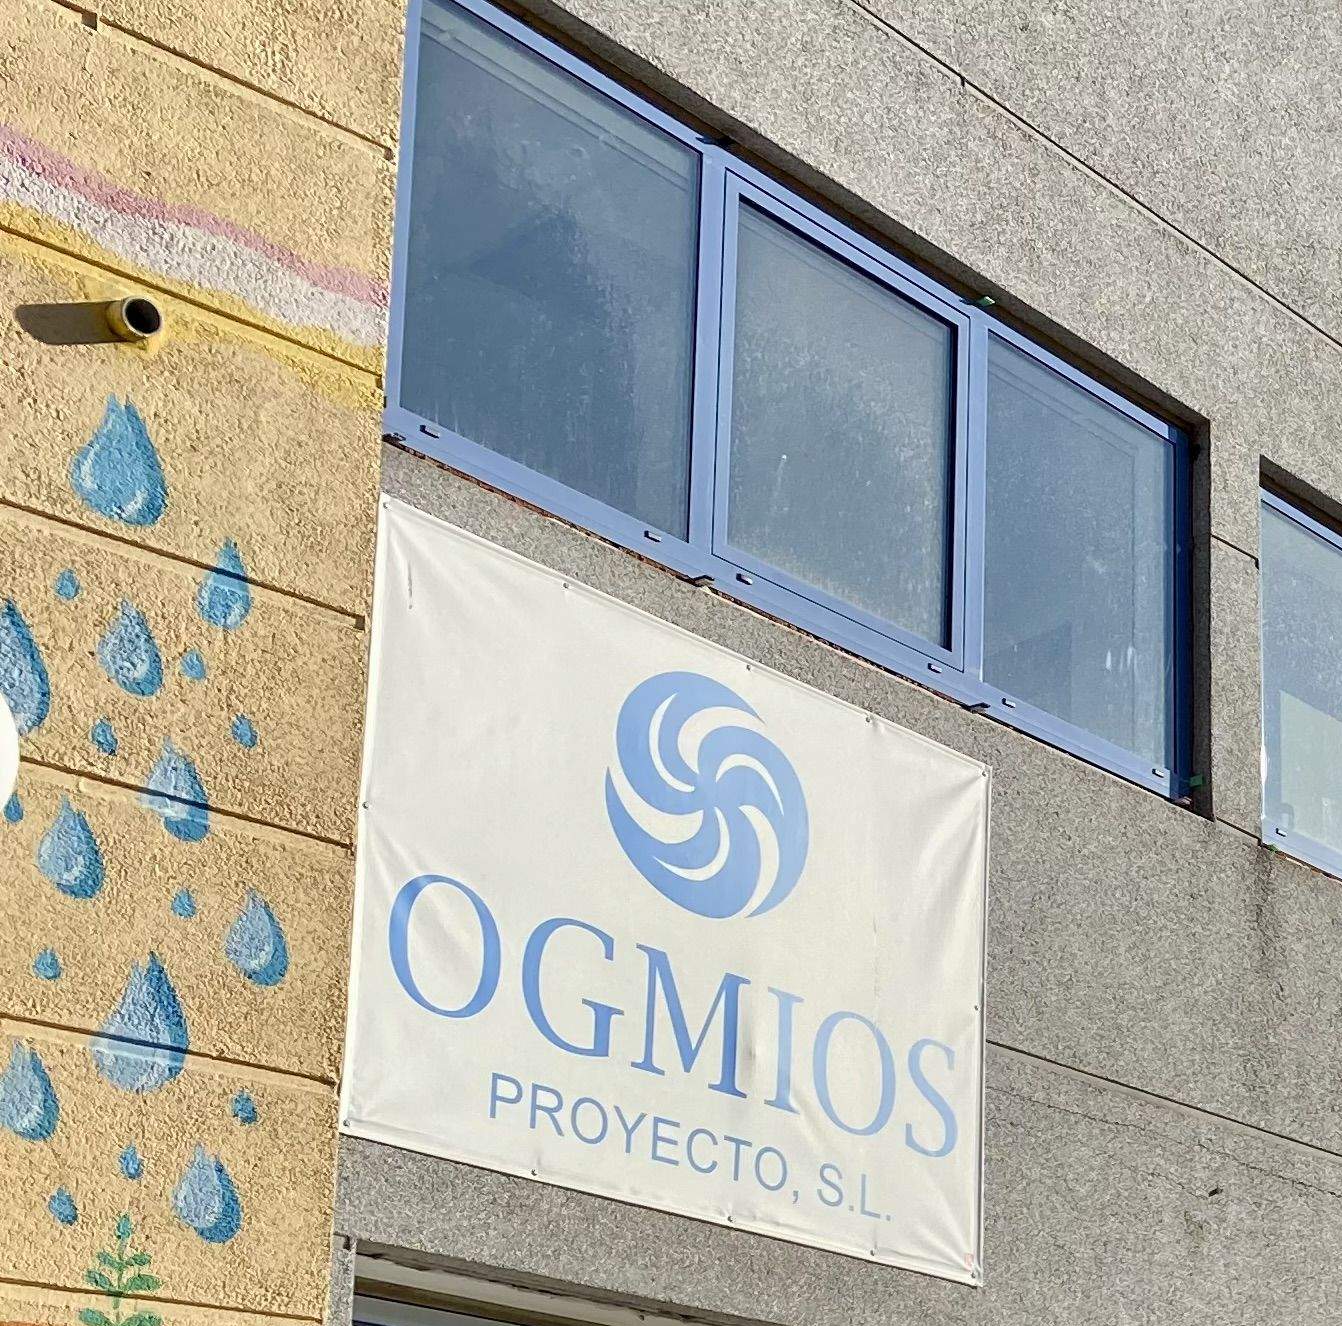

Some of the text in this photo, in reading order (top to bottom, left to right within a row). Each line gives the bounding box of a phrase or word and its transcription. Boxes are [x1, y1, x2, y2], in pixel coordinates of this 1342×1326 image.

[388, 874, 960, 1159] OGMIOS
[489, 1072, 892, 1222] PROYECTO, S.L.
